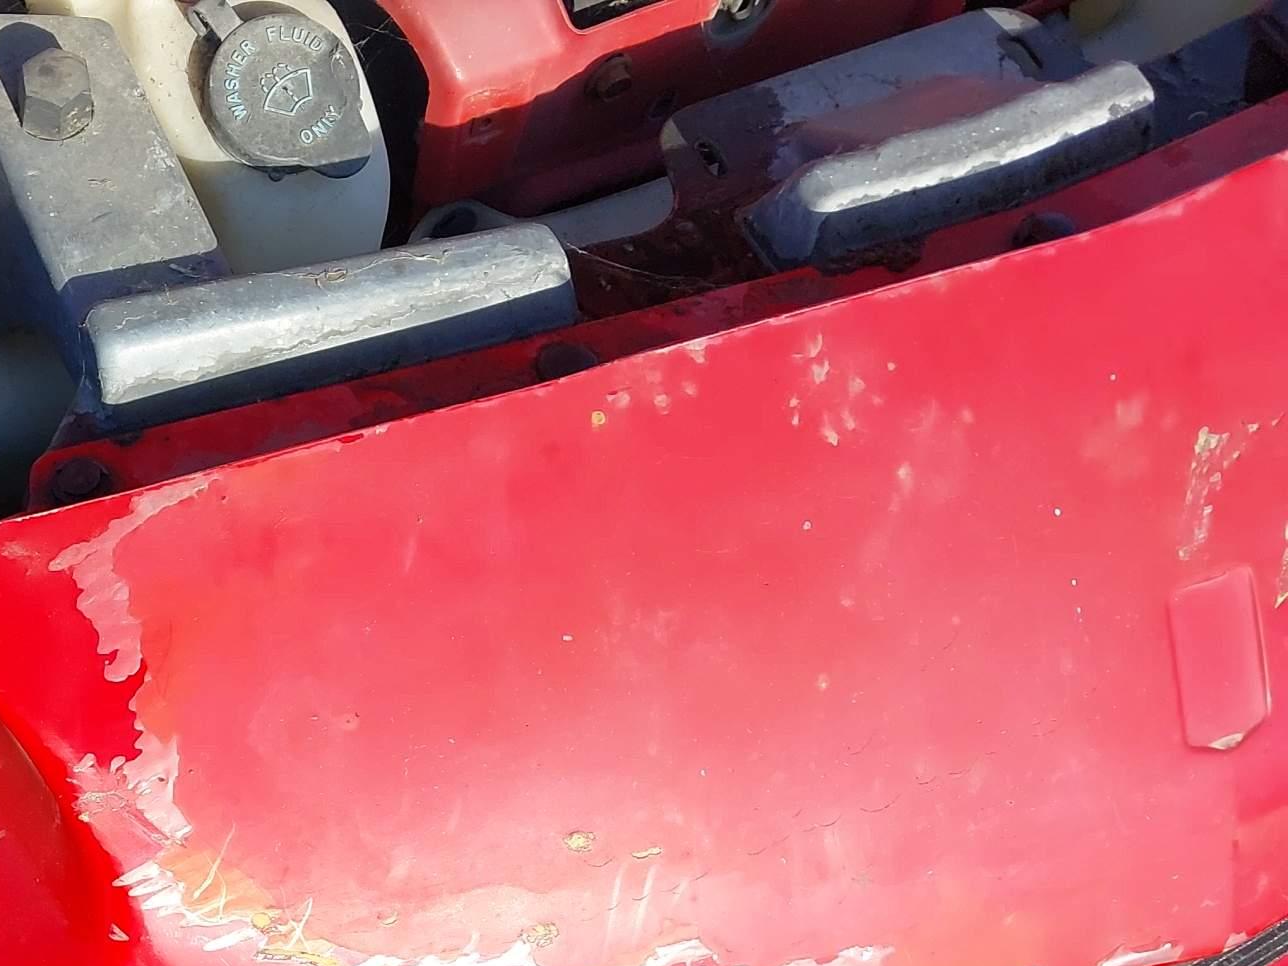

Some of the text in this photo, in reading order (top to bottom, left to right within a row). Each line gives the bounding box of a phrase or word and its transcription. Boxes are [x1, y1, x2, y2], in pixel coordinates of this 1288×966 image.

[224, 26, 323, 120] WASHER FLUID
[300, 105, 342, 144] ONLY
